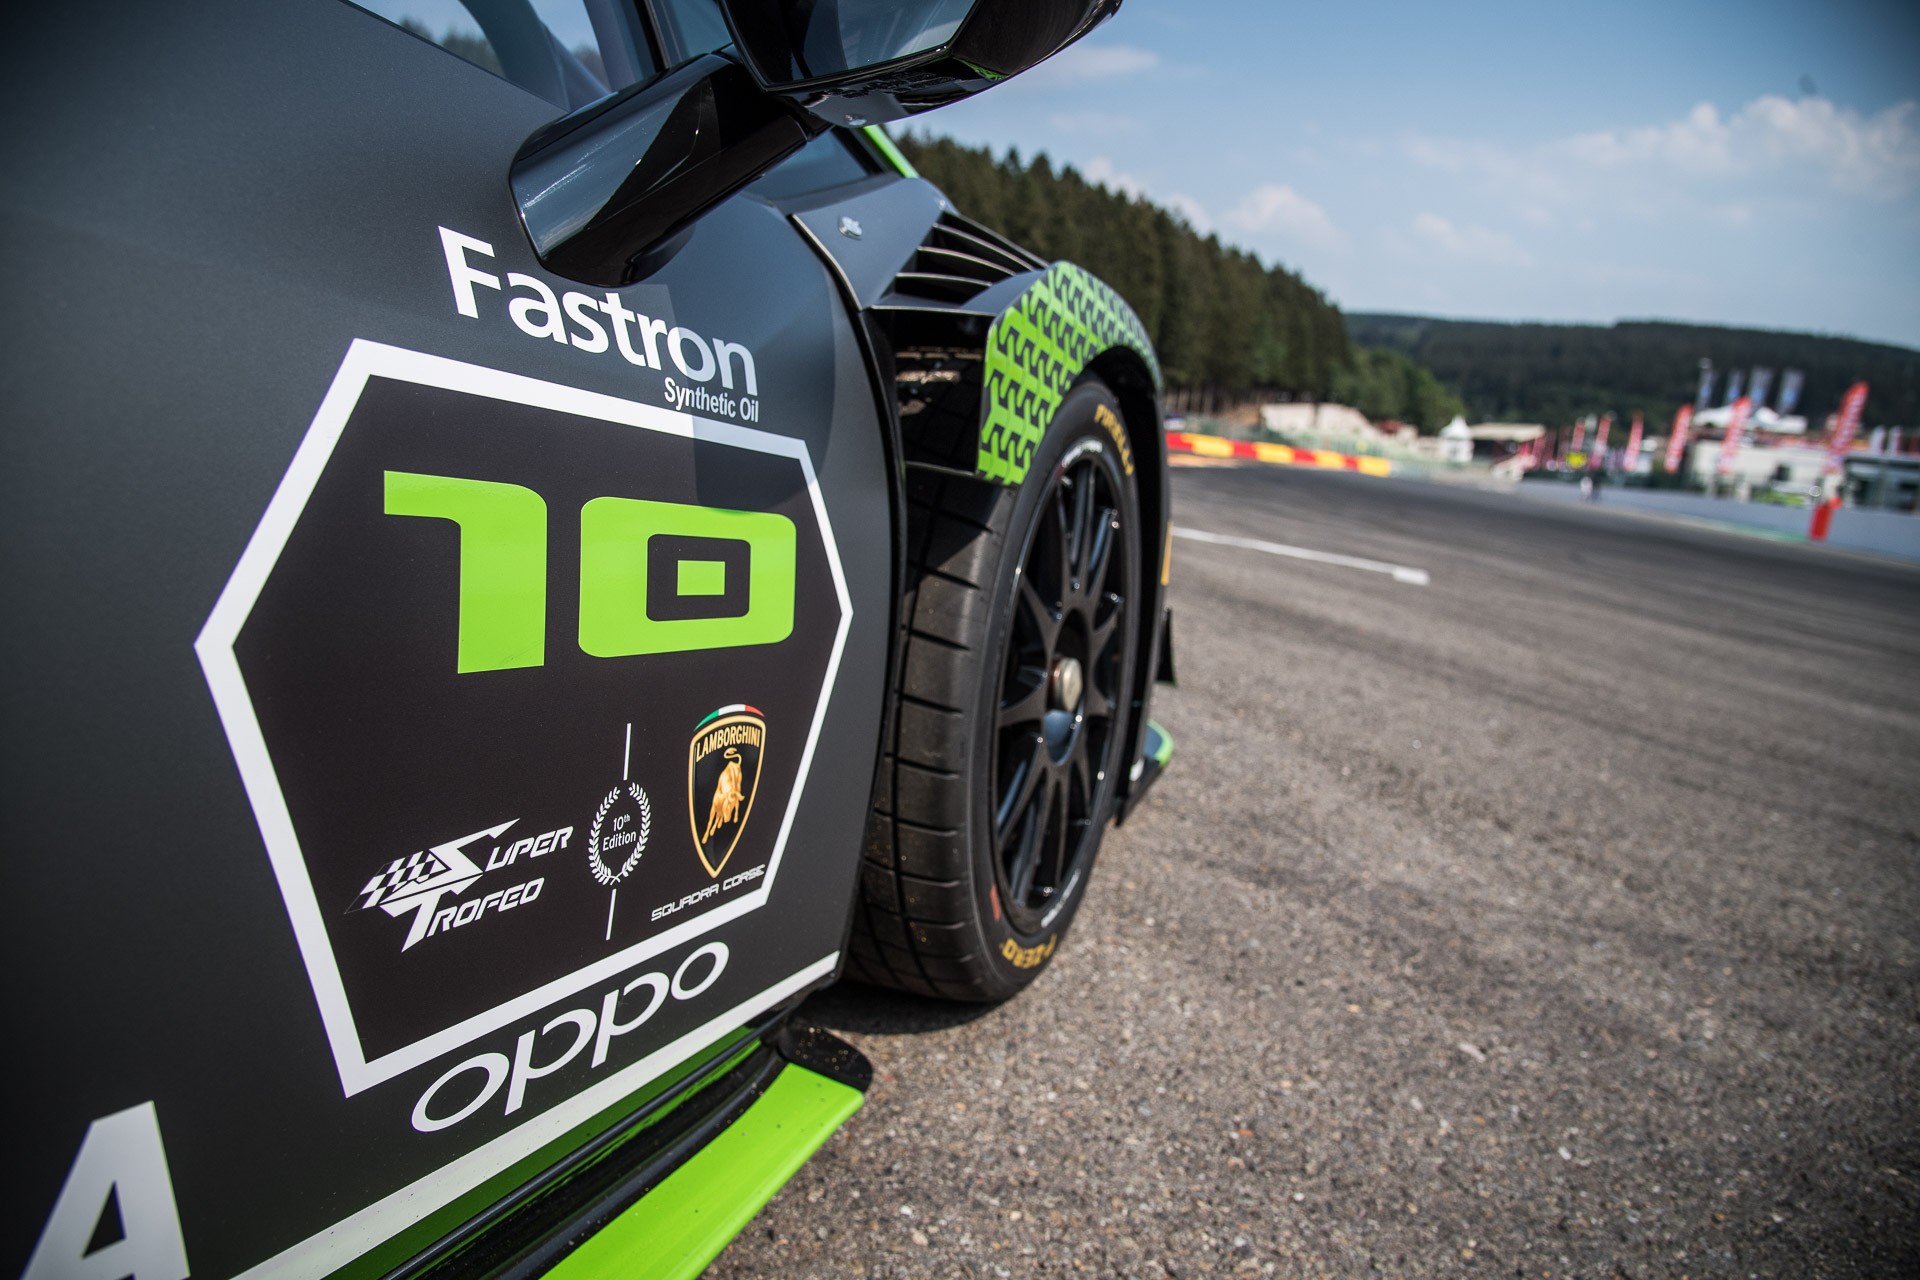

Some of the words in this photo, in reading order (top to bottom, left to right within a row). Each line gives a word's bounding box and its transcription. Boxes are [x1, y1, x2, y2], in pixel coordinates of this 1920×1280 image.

[438, 225, 758, 396] Fastron
[664, 377, 736, 419] Synthetic
[740, 396, 759, 423] Oil
[384, 470, 797, 674] 10
[695, 725, 761, 762] LAMBORGHINI
[393, 818, 574, 893] SUPER
[602, 831, 637, 852] Edition
[613, 813, 631, 832] 10th
[379, 874, 545, 953] TROFEO
[651, 883, 720, 922] SQUADRA
[722, 864, 766, 891] CORSE
[411, 941, 730, 1132] oppo
[22, 1100, 191, 1280] A
